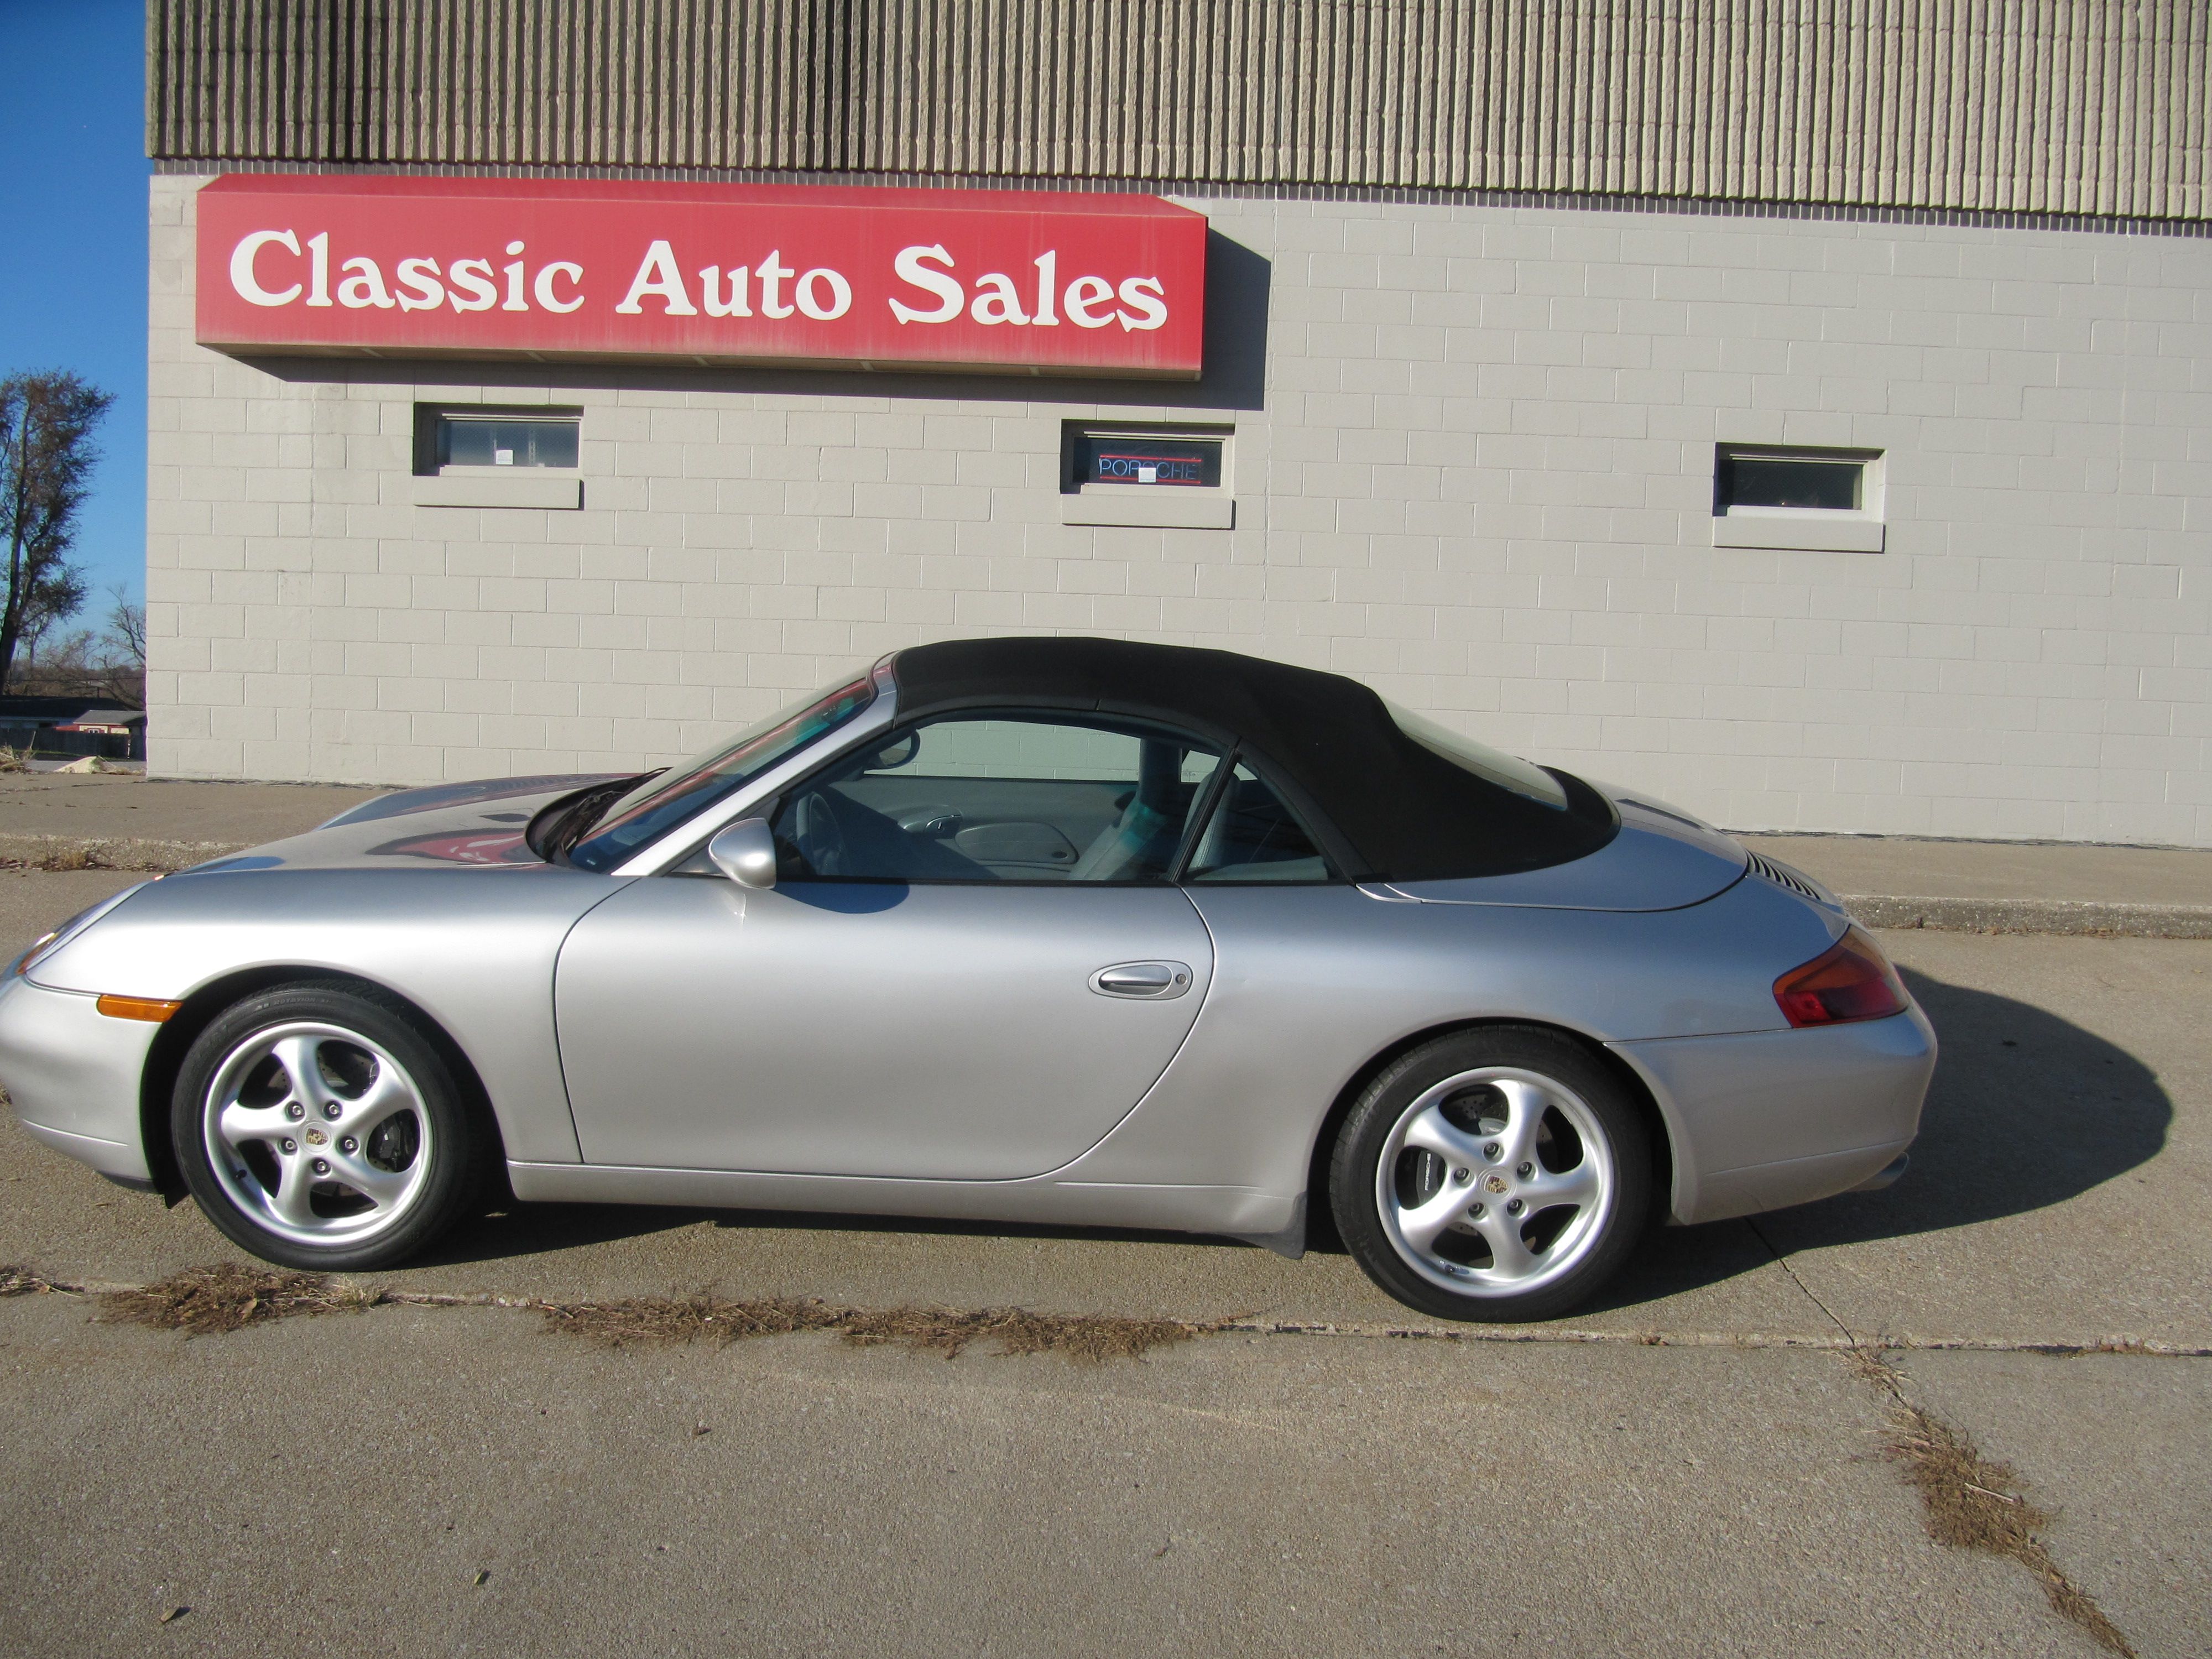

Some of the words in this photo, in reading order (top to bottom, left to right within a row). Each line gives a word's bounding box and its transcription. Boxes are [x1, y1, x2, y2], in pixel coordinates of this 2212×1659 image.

[228, 228, 586, 314] Classic
[614, 239, 853, 321] Auto
[888, 243, 1168, 333] Sales
